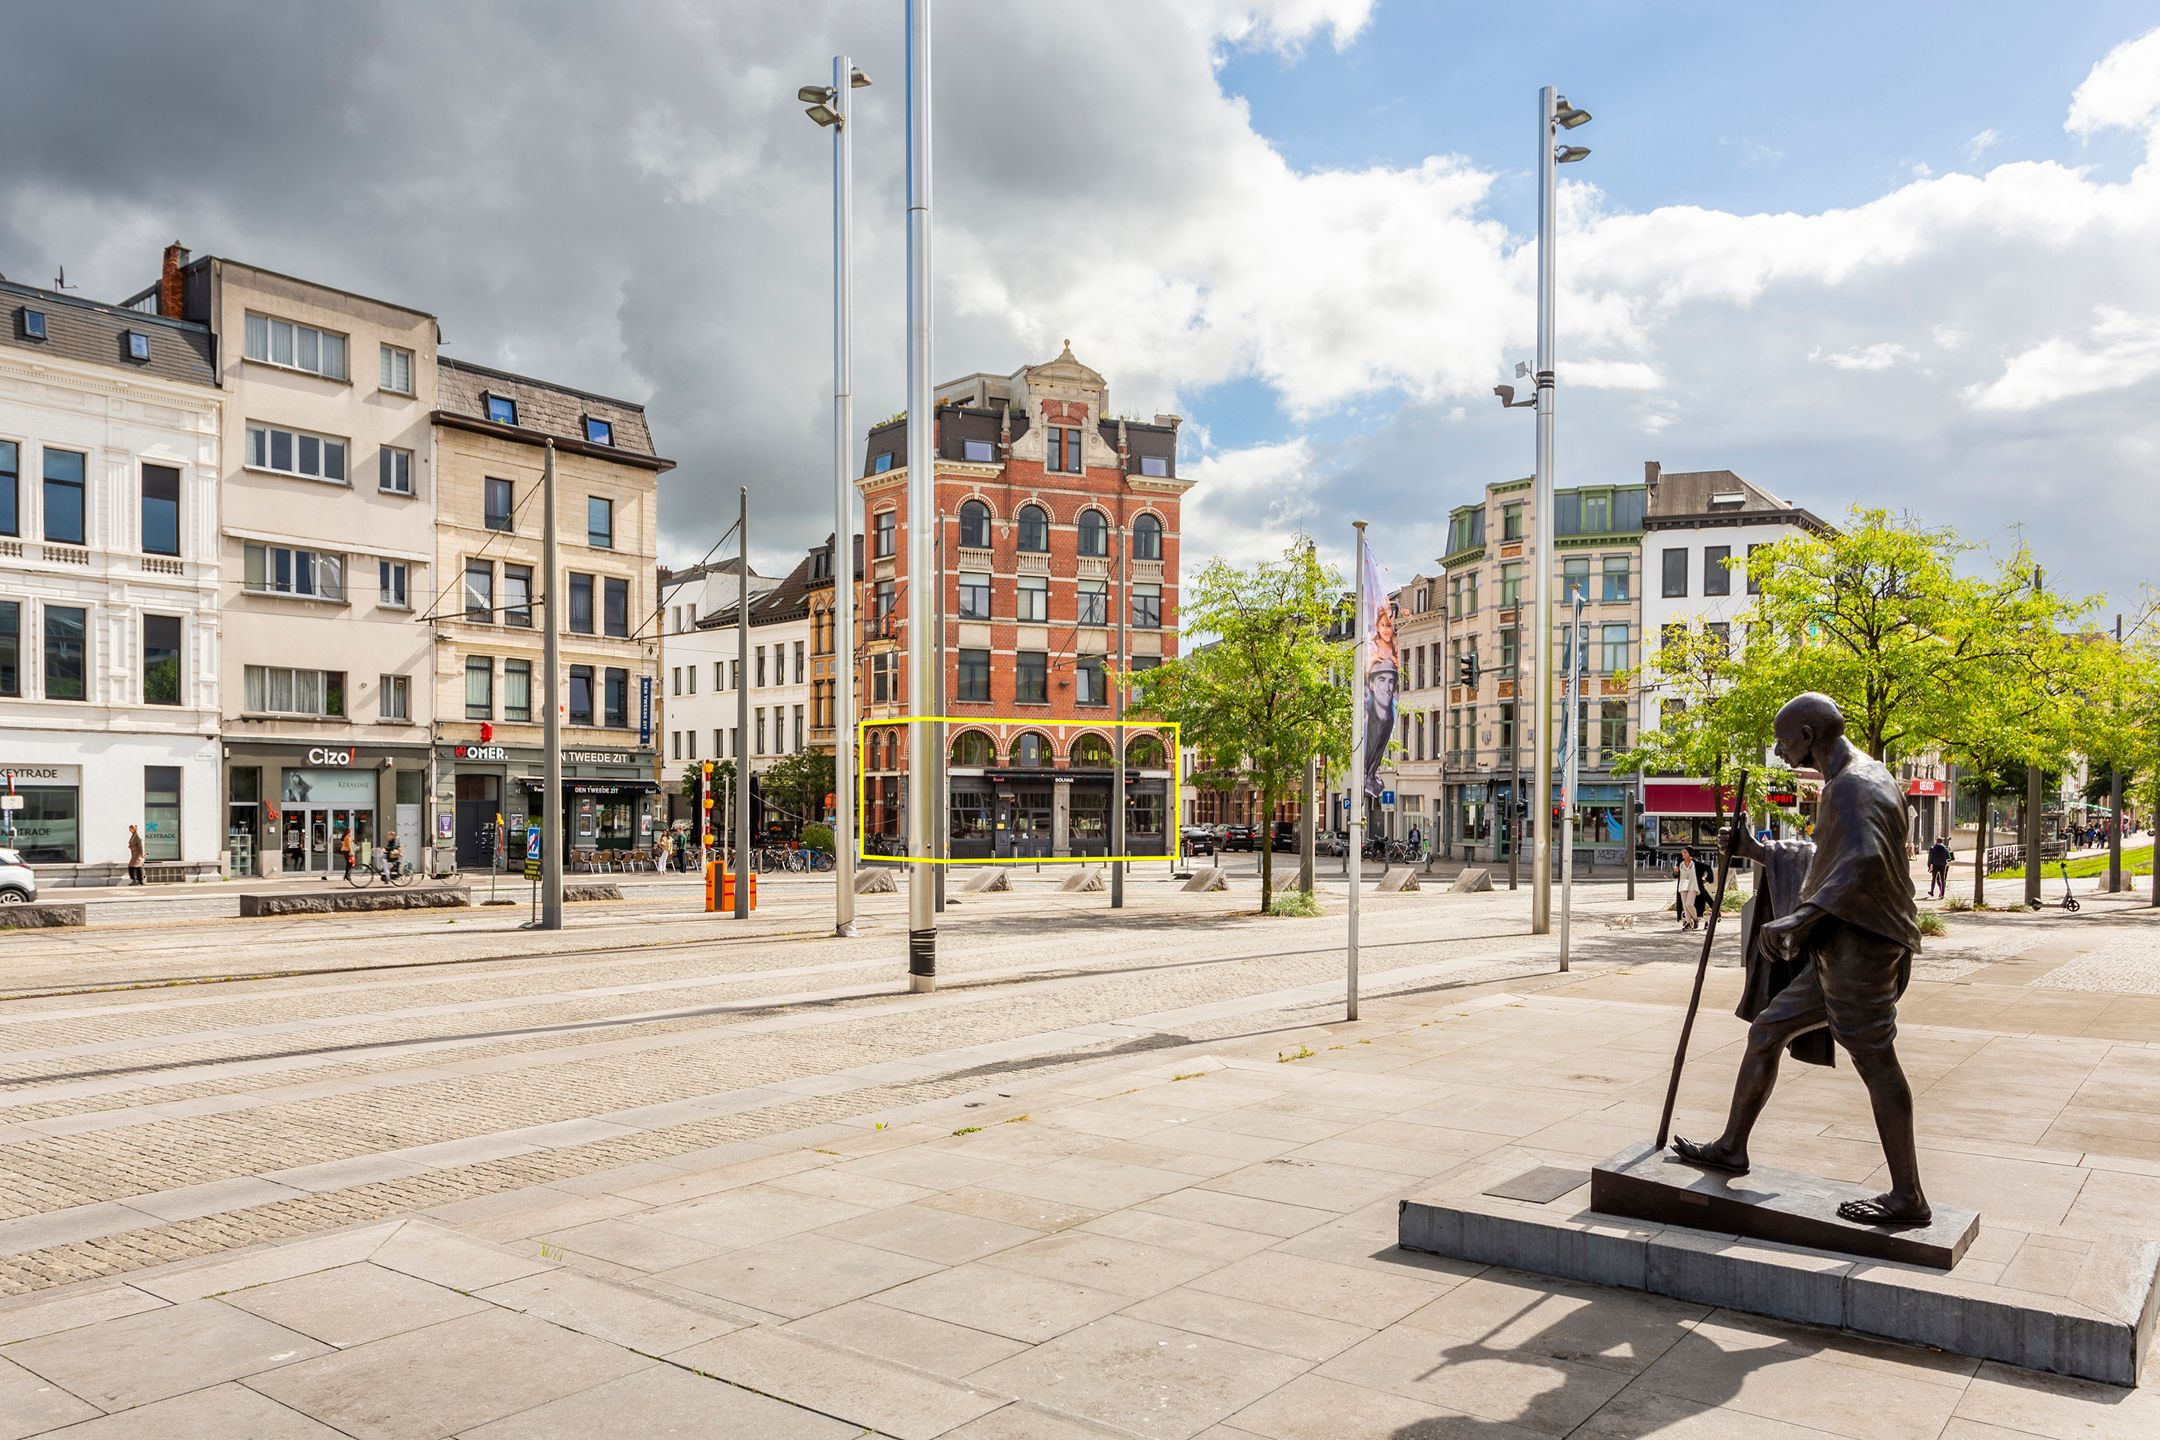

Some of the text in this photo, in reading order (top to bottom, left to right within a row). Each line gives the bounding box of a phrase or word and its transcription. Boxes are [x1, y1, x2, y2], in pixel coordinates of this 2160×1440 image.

[308, 746, 356, 766] Cizo!
[569, 752, 611, 762] TWEEDE
[613, 753, 628, 764] ZIT
[1344, 800, 1350, 808] P
